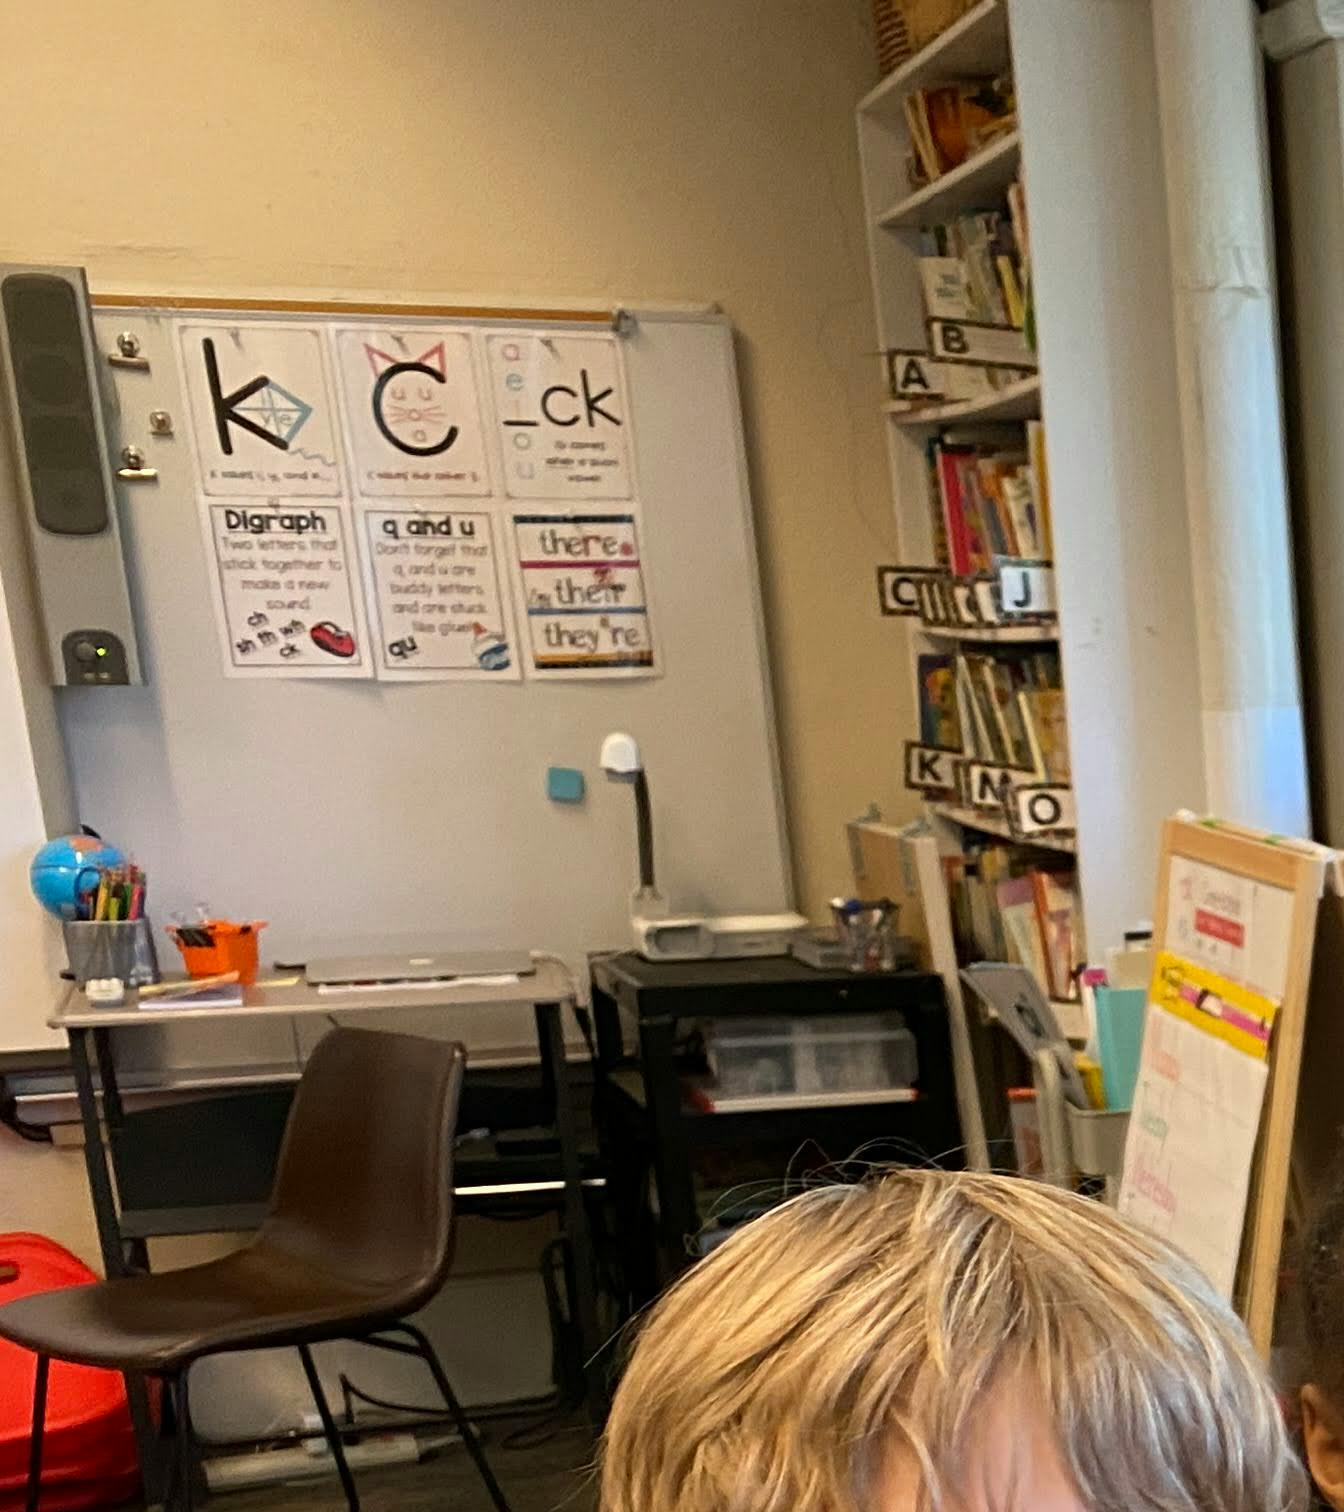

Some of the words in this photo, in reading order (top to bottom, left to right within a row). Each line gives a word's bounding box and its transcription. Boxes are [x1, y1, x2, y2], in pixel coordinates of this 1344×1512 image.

[942, 324, 970, 354] B
[901, 358, 930, 390] A
[225, 508, 327, 535] Digraph
[382, 519, 399, 540] q
[406, 514, 453, 536] and
[459, 519, 475, 536] u
[257, 538, 306, 551] letters
[540, 529, 619, 557] there
[261, 558, 325, 573] together
[409, 563, 436, 576] and
[240, 579, 281, 591] make
[299, 580, 330, 591] new
[1013, 572, 1032, 608] J
[393, 600, 419, 614] and
[422, 603, 447, 614] are
[388, 635, 418, 660] qu
[545, 621, 641, 654] they're
[917, 753, 943, 782] K
[1028, 793, 1062, 826] O
